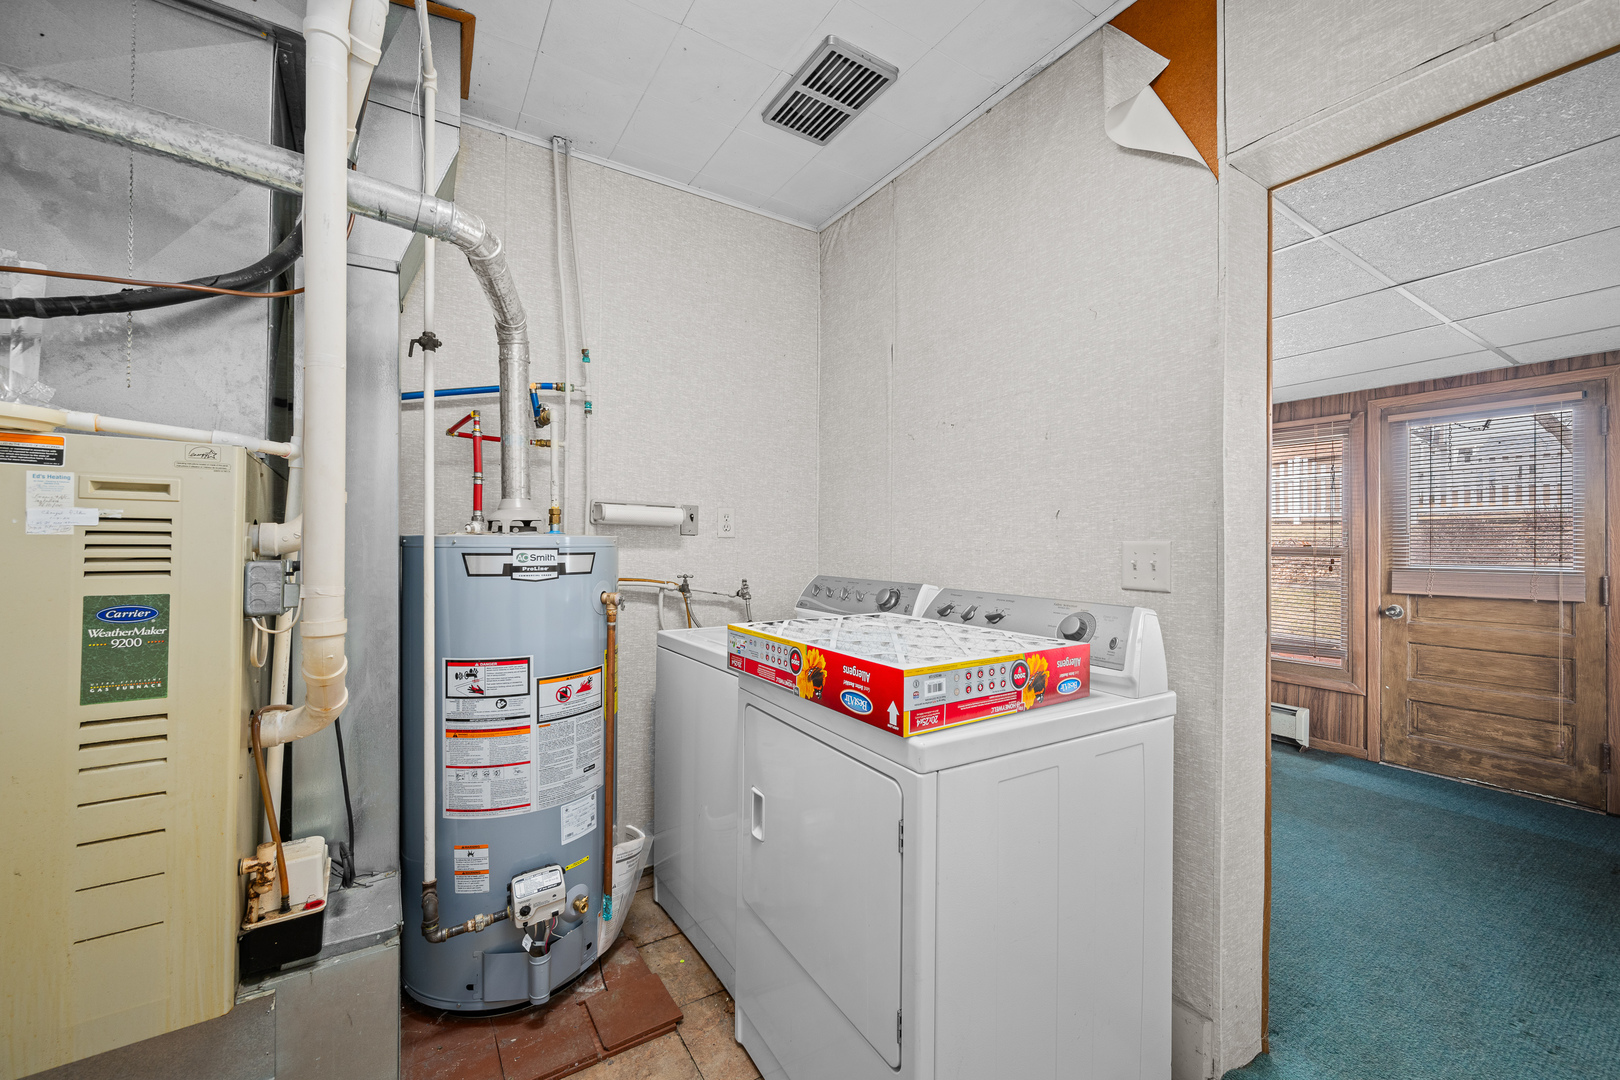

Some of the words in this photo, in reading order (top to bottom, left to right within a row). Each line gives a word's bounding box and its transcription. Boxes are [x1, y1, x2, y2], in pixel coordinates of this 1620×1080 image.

[530, 553, 556, 562] Smith
[105, 610, 151, 619] Carrier
[88, 626, 167, 638] WeatherMaker
[110, 637, 142, 649] 9200
[1056, 656, 1081, 668] Allergens
[842, 665, 870, 683] Allergens
[116, 683, 162, 691] FURNACE
[1060, 681, 1078, 692] BestAir
[844, 694, 868, 711] BestAir
